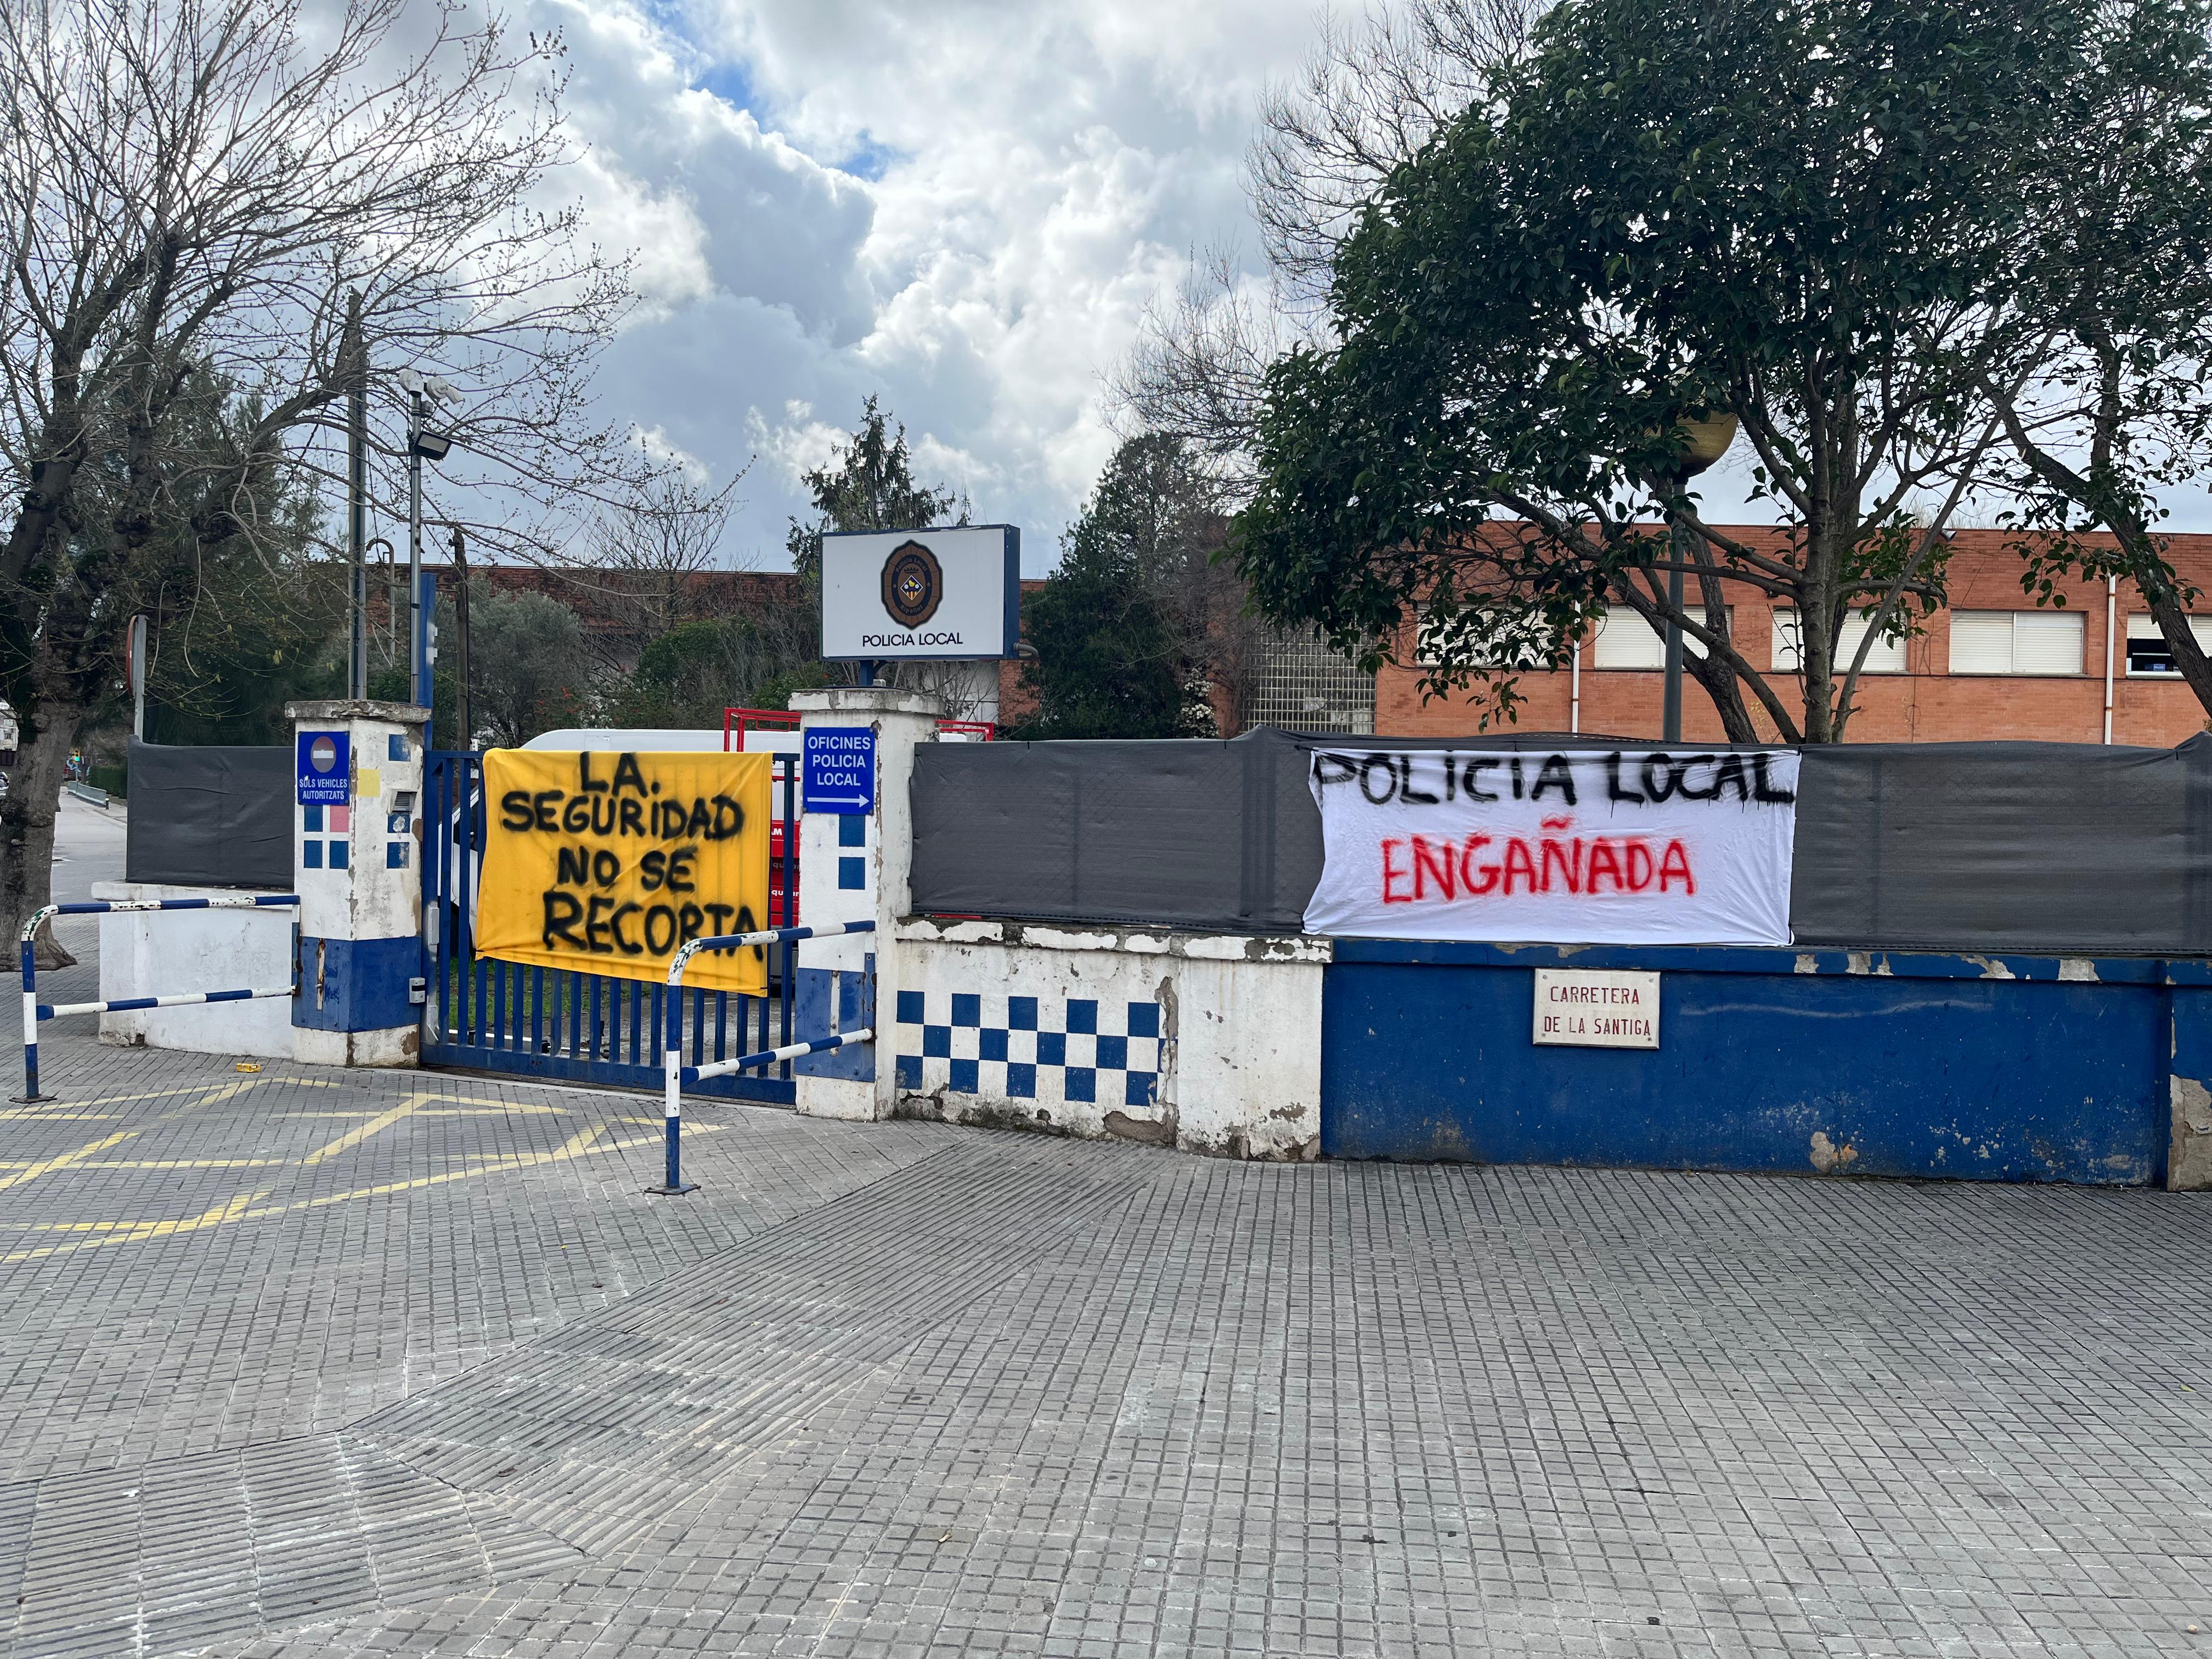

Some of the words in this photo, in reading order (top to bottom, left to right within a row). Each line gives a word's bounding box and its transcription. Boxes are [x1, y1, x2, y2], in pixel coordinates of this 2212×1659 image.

[862, 634, 915, 647] POLICIA
[919, 633, 963, 646] LOCAL
[808, 736, 871, 750] OFICINES
[812, 754, 866, 768] POLICIA
[299, 778, 316, 788] SOLS
[318, 778, 348, 788] VEHICLES
[817, 772, 861, 786] LOCAL
[1313, 751, 1578, 806] POLICIA
[1605, 752, 1796, 810] LOCAL
[302, 791, 345, 800] AUTORITZATS
[501, 789, 746, 841] SEGURIDAD
[557, 845, 621, 890] NO
[639, 845, 697, 893] SE
[1380, 814, 1697, 905] ENGAÑADA
[542, 890, 764, 962] RECORTA
[1550, 986, 1640, 1005] CARRETERA
[1544, 1016, 1561, 1033] DE
[1569, 1017, 1585, 1034] LA
[1594, 1018, 1651, 1036] SANTIGA
